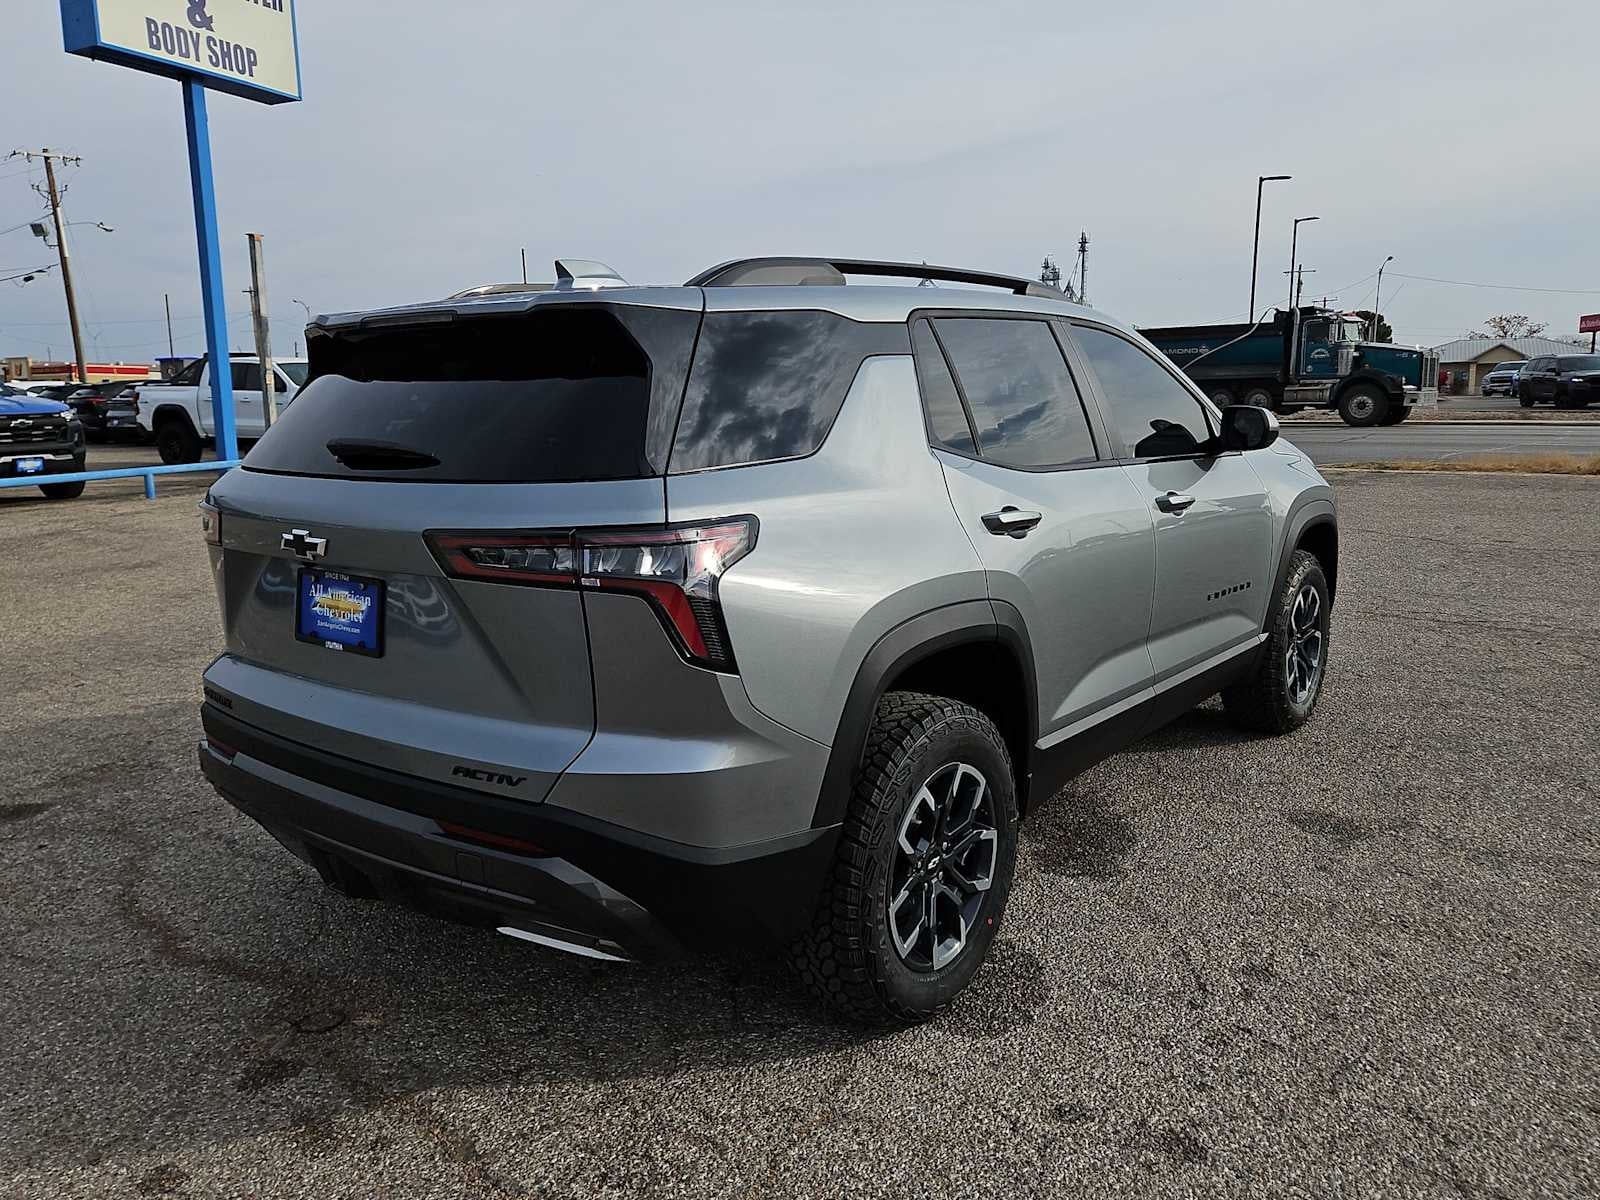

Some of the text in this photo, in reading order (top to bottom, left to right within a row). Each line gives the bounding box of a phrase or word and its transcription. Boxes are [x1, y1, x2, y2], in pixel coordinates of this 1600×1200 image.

[187, 0, 215, 31] &
[145, 17, 258, 77] BODY SHOP
[309, 584, 372, 607] All American
[316, 603, 365, 624] Chevrolet
[452, 765, 528, 787] ACTIV
